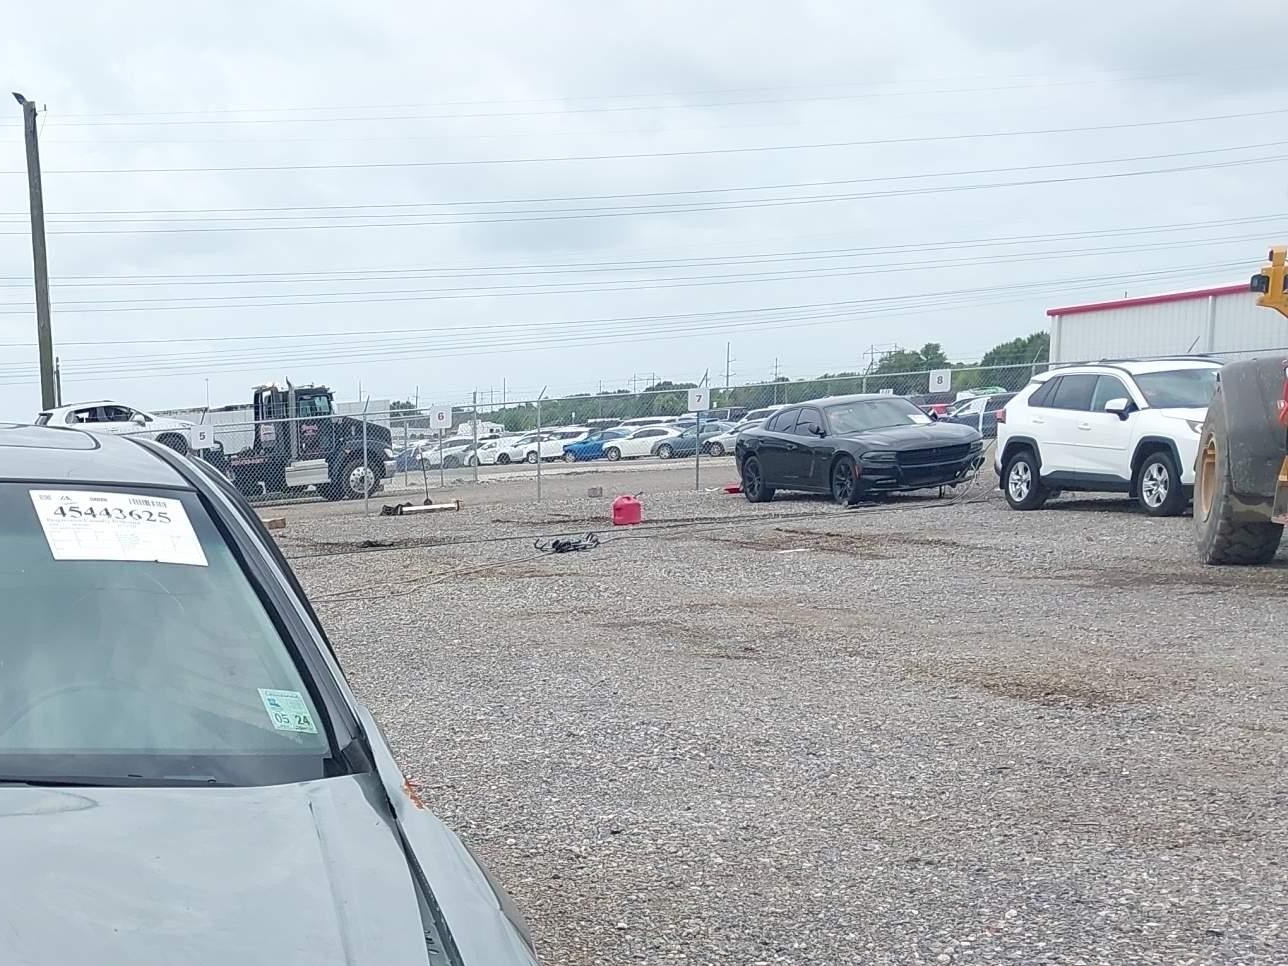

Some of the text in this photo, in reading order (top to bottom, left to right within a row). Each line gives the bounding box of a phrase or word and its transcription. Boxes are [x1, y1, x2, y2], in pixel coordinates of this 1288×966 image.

[936, 375, 943, 385] 8
[695, 394, 703, 403] 7
[437, 412, 444, 421] 6
[199, 431, 206, 440] 5
[53, 505, 172, 525] 45443625
[274, 712, 310, 726] 05 24
